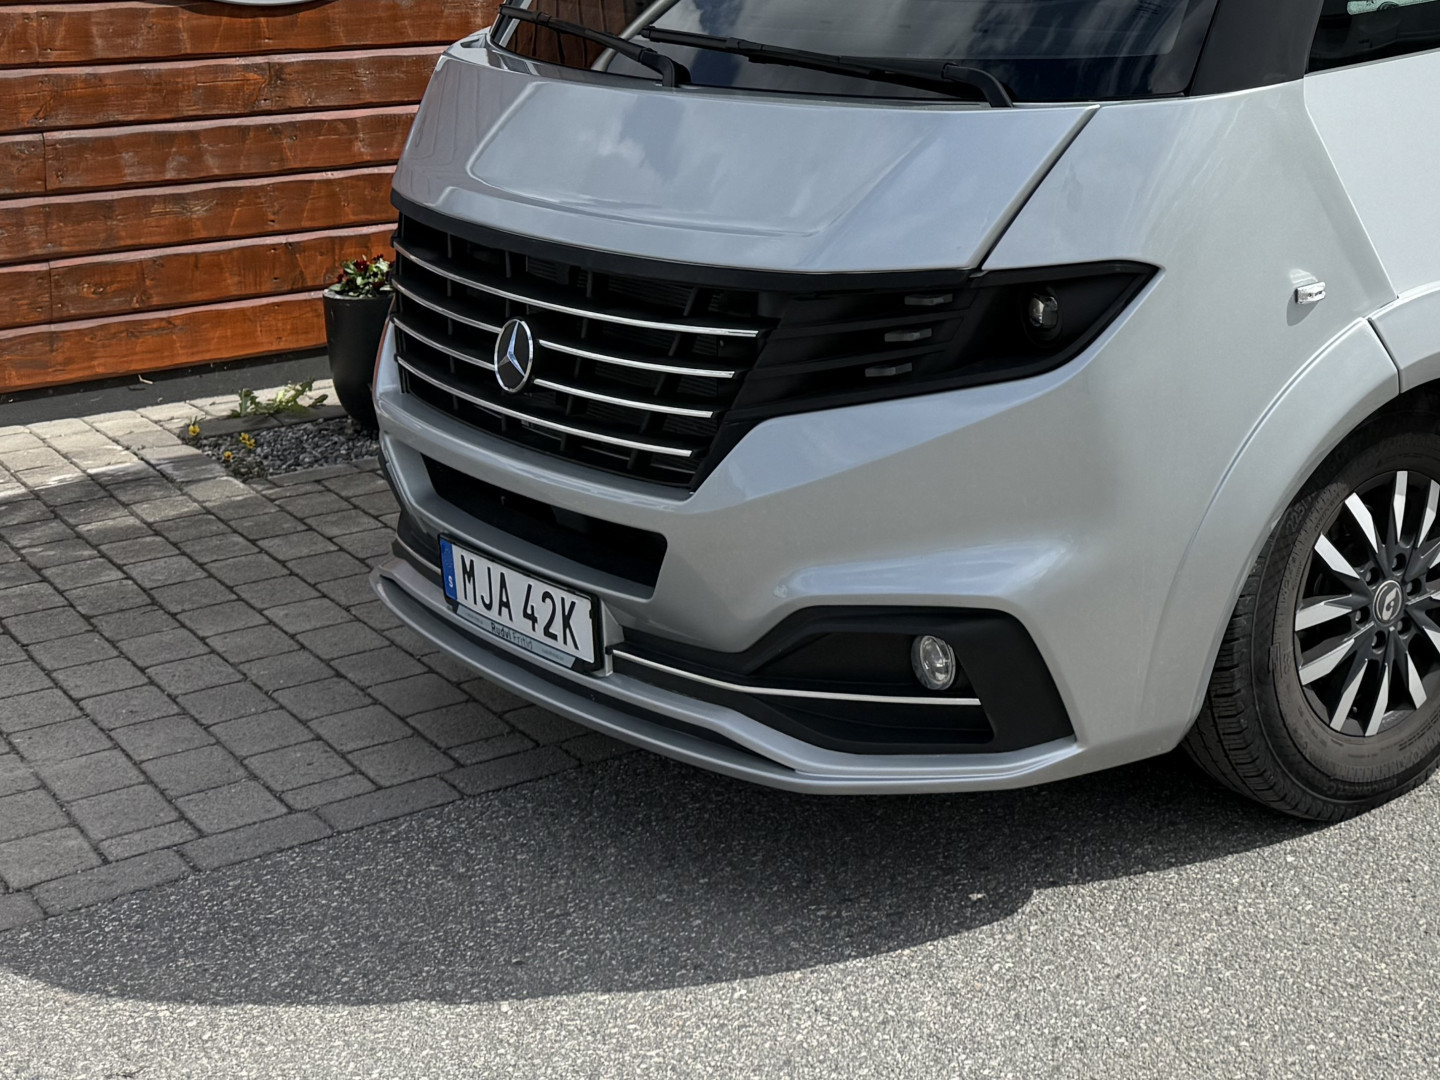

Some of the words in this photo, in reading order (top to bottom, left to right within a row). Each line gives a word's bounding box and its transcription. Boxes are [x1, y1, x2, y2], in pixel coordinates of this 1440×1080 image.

[448, 575, 454, 588] S
[460, 554, 514, 622] MJA
[522, 583, 580, 651] 42K
